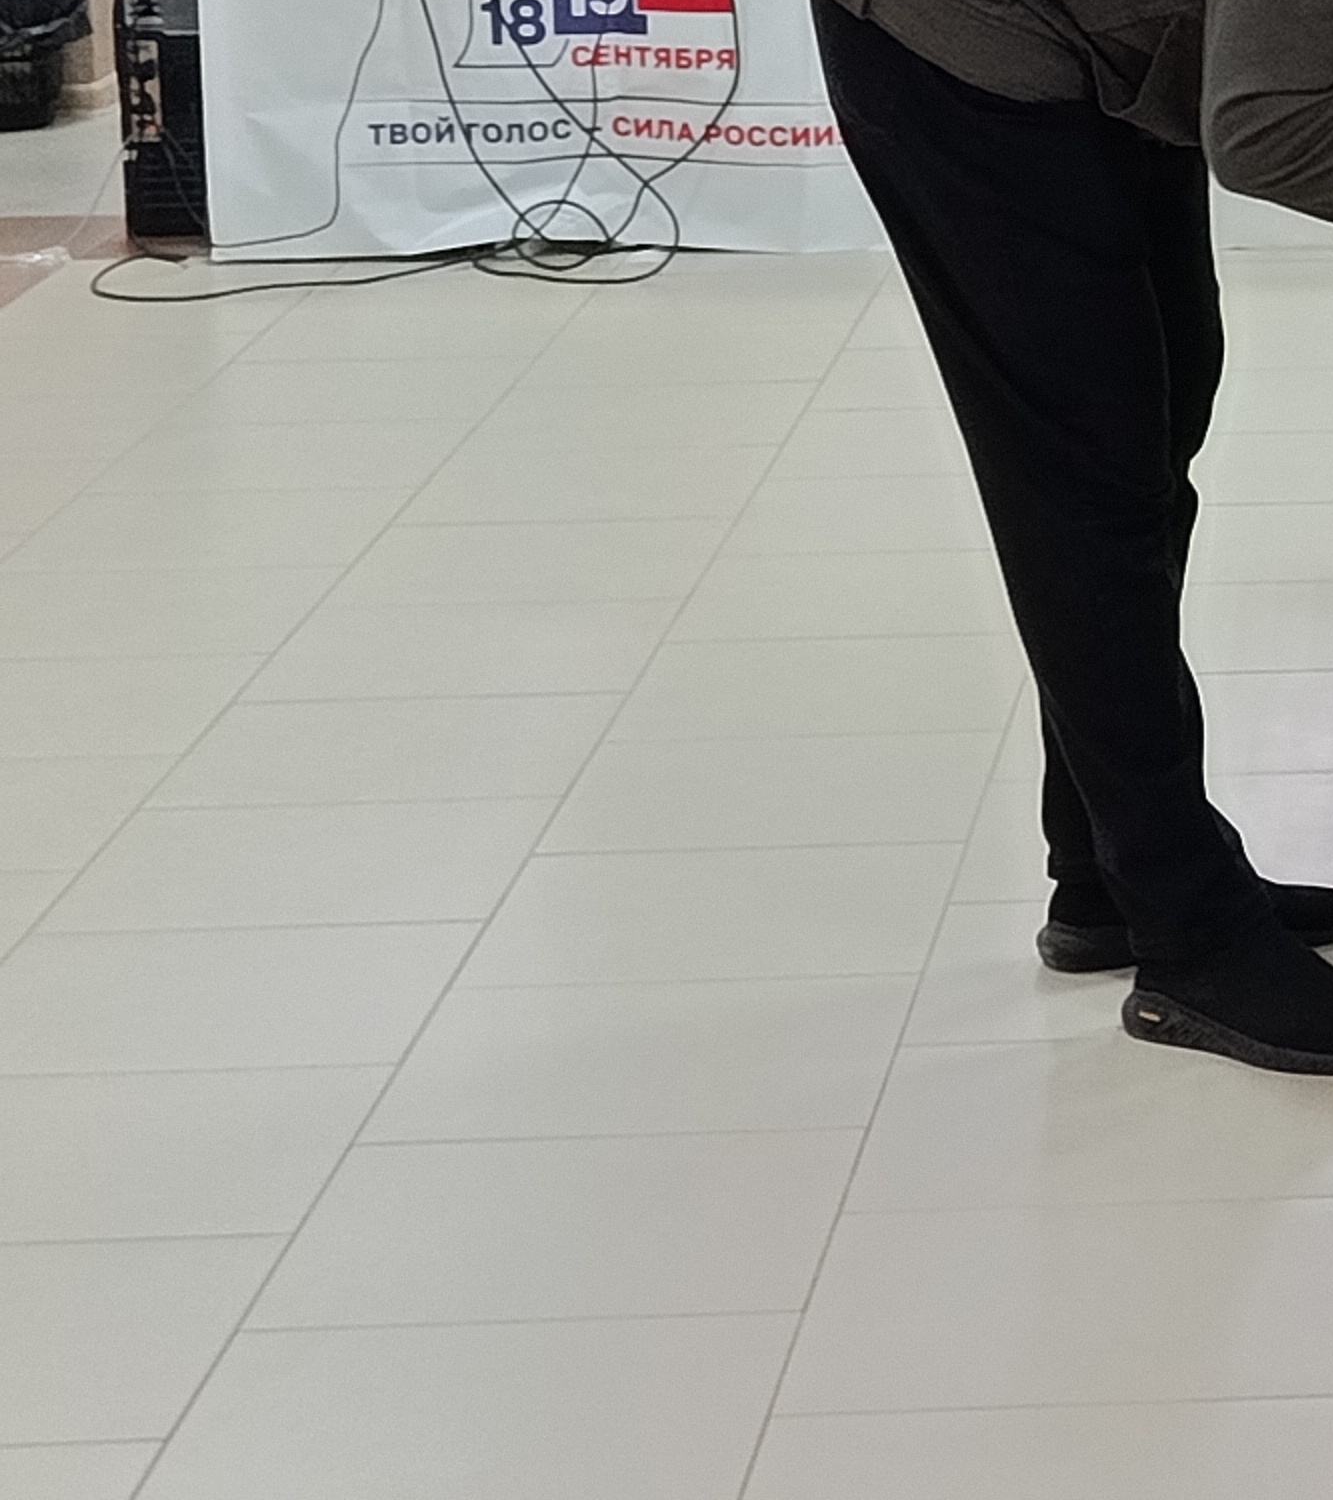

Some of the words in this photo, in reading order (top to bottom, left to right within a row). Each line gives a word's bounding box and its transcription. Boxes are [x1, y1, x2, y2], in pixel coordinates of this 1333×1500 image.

[571, 45, 735, 69] СЕНТЯБРЯ
[368, 117, 455, 145] ТВОЙ
[468, 119, 572, 144] ГОЛОС
[612, 116, 695, 143] СИЛА
